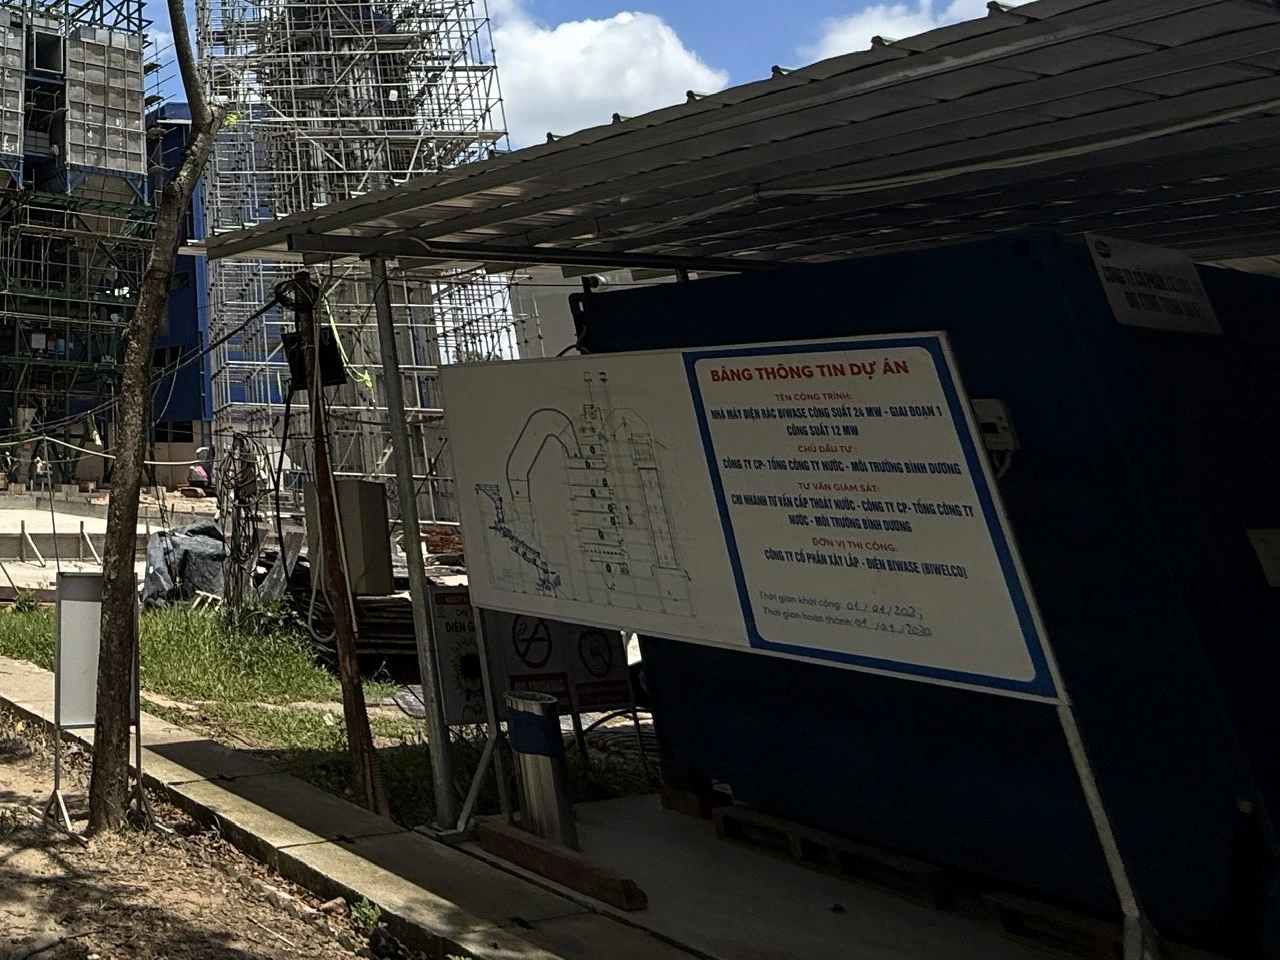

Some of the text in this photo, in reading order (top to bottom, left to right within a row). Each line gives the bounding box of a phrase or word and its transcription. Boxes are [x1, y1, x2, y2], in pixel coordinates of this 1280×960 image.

[710, 358, 910, 382] BẢNG THÔNG TIN DỰ ÁN
[774, 391, 852, 402] TÊN CÔNG TRÌNH:
[710, 408, 726, 419] NHÀ
[727, 407, 742, 419] MÁY
[743, 406, 760, 421] ĐIỆN
[761, 406, 777, 419] RÁC
[778, 408, 807, 419] BIWASE
[809, 406, 830, 418] CÔNG
[832, 404, 852, 417] SUẤT
[854, 406, 864, 417] 24
[866, 406, 882, 417] MW
[890, 406, 908, 417] GIAI
[909, 406, 935, 419] ĐOẠN
[936, 406, 942, 417] 1
[787, 422, 859, 436] CÔNG SUẤT 12 MW
[798, 444, 852, 453] CHỦ ĐẦU TƯ
[723, 456, 742, 469] CÔNG
[744, 460, 752, 469] TY
[767, 456, 787, 470] TỔNG
[788, 458, 809, 471] CÔNG
[810, 461, 820, 471] TY
[822, 459, 845, 472] NƯỚC
[850, 459, 868, 472] MÔI
[869, 459, 904, 474] TRƯỜNG
[906, 460, 928, 474] BÌNH
[929, 462, 962, 474] DƯƠNG
[798, 482, 811, 490] TƯ
[812, 481, 832, 491] VẤN
[834, 482, 858, 492] GIÁM
[732, 494, 743, 505] CHI
[744, 494, 768, 506] NHÁNH
[768, 496, 778, 507] TƯ
[779, 493, 794, 508] VẤN
[794, 493, 808, 508] CẤP
[810, 496, 834, 510] THOÁT
[835, 498, 856, 511] NƯỚC
[862, 498, 884, 512] CÔNG
[885, 502, 895, 513] TY
[912, 498, 937, 515] TỔNG
[938, 502, 962, 516] CÔNG
[962, 505, 974, 518] TY
[788, 513, 809, 526] NƯỚC
[814, 514, 830, 527] MÔI
[831, 515, 862, 529] TRƯỜNG
[862, 516, 882, 530] BÌNH
[884, 519, 912, 532] DƯƠNG
[812, 537, 834, 547] ĐƠN
[835, 540, 846, 550] VỊ
[847, 540, 864, 550] THI
[764, 547, 785, 562] CÔNG
[786, 550, 794, 562] TY
[795, 548, 806, 562] CỔ
[806, 550, 828, 565] PHẦN
[828, 553, 845, 566] XÂY
[845, 552, 860, 568] LẮP
[866, 556, 886, 572] ĐIỆN
[888, 560, 922, 574] BIWASE
[922, 562, 968, 580] (BIWELCO)
[760, 590, 777, 601] Thời
[778, 595, 796, 604] gian
